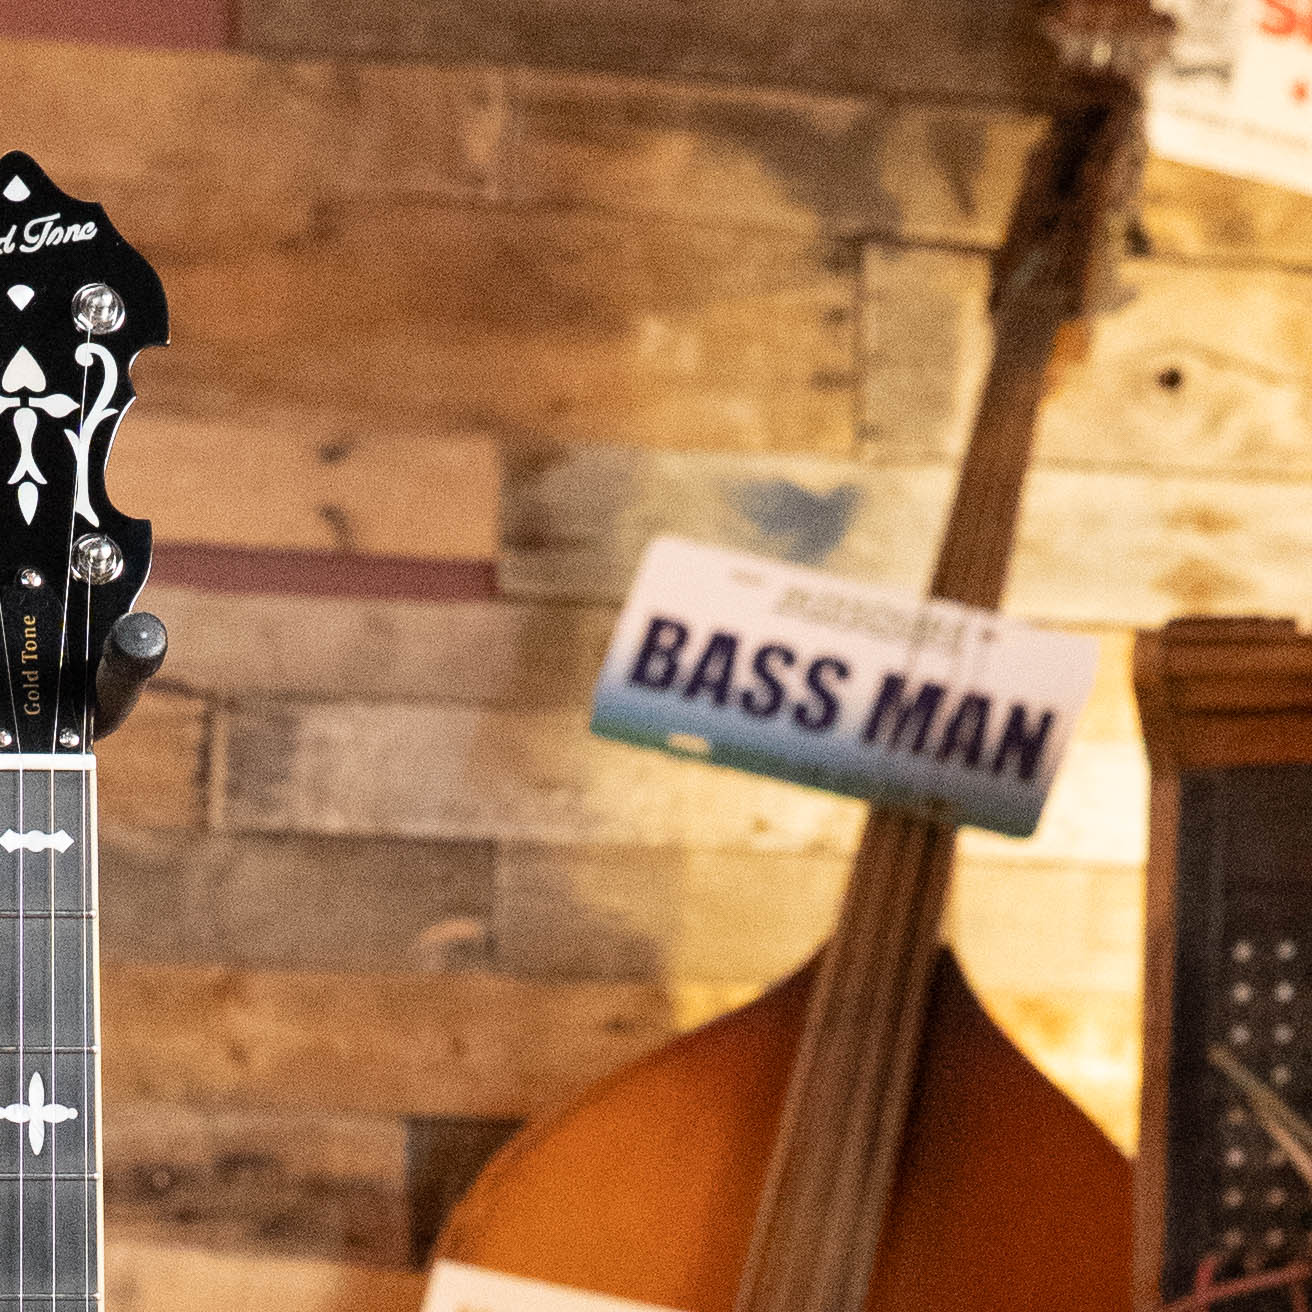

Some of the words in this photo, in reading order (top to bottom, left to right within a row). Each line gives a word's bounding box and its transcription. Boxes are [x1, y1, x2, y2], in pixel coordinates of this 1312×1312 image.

[19, 212, 98, 253] Tone
[21, 615, 38, 664] Tone
[23, 670, 41, 716] Gold
[626, 616, 851, 734] BASS
[861, 672, 1058, 784] MAN
